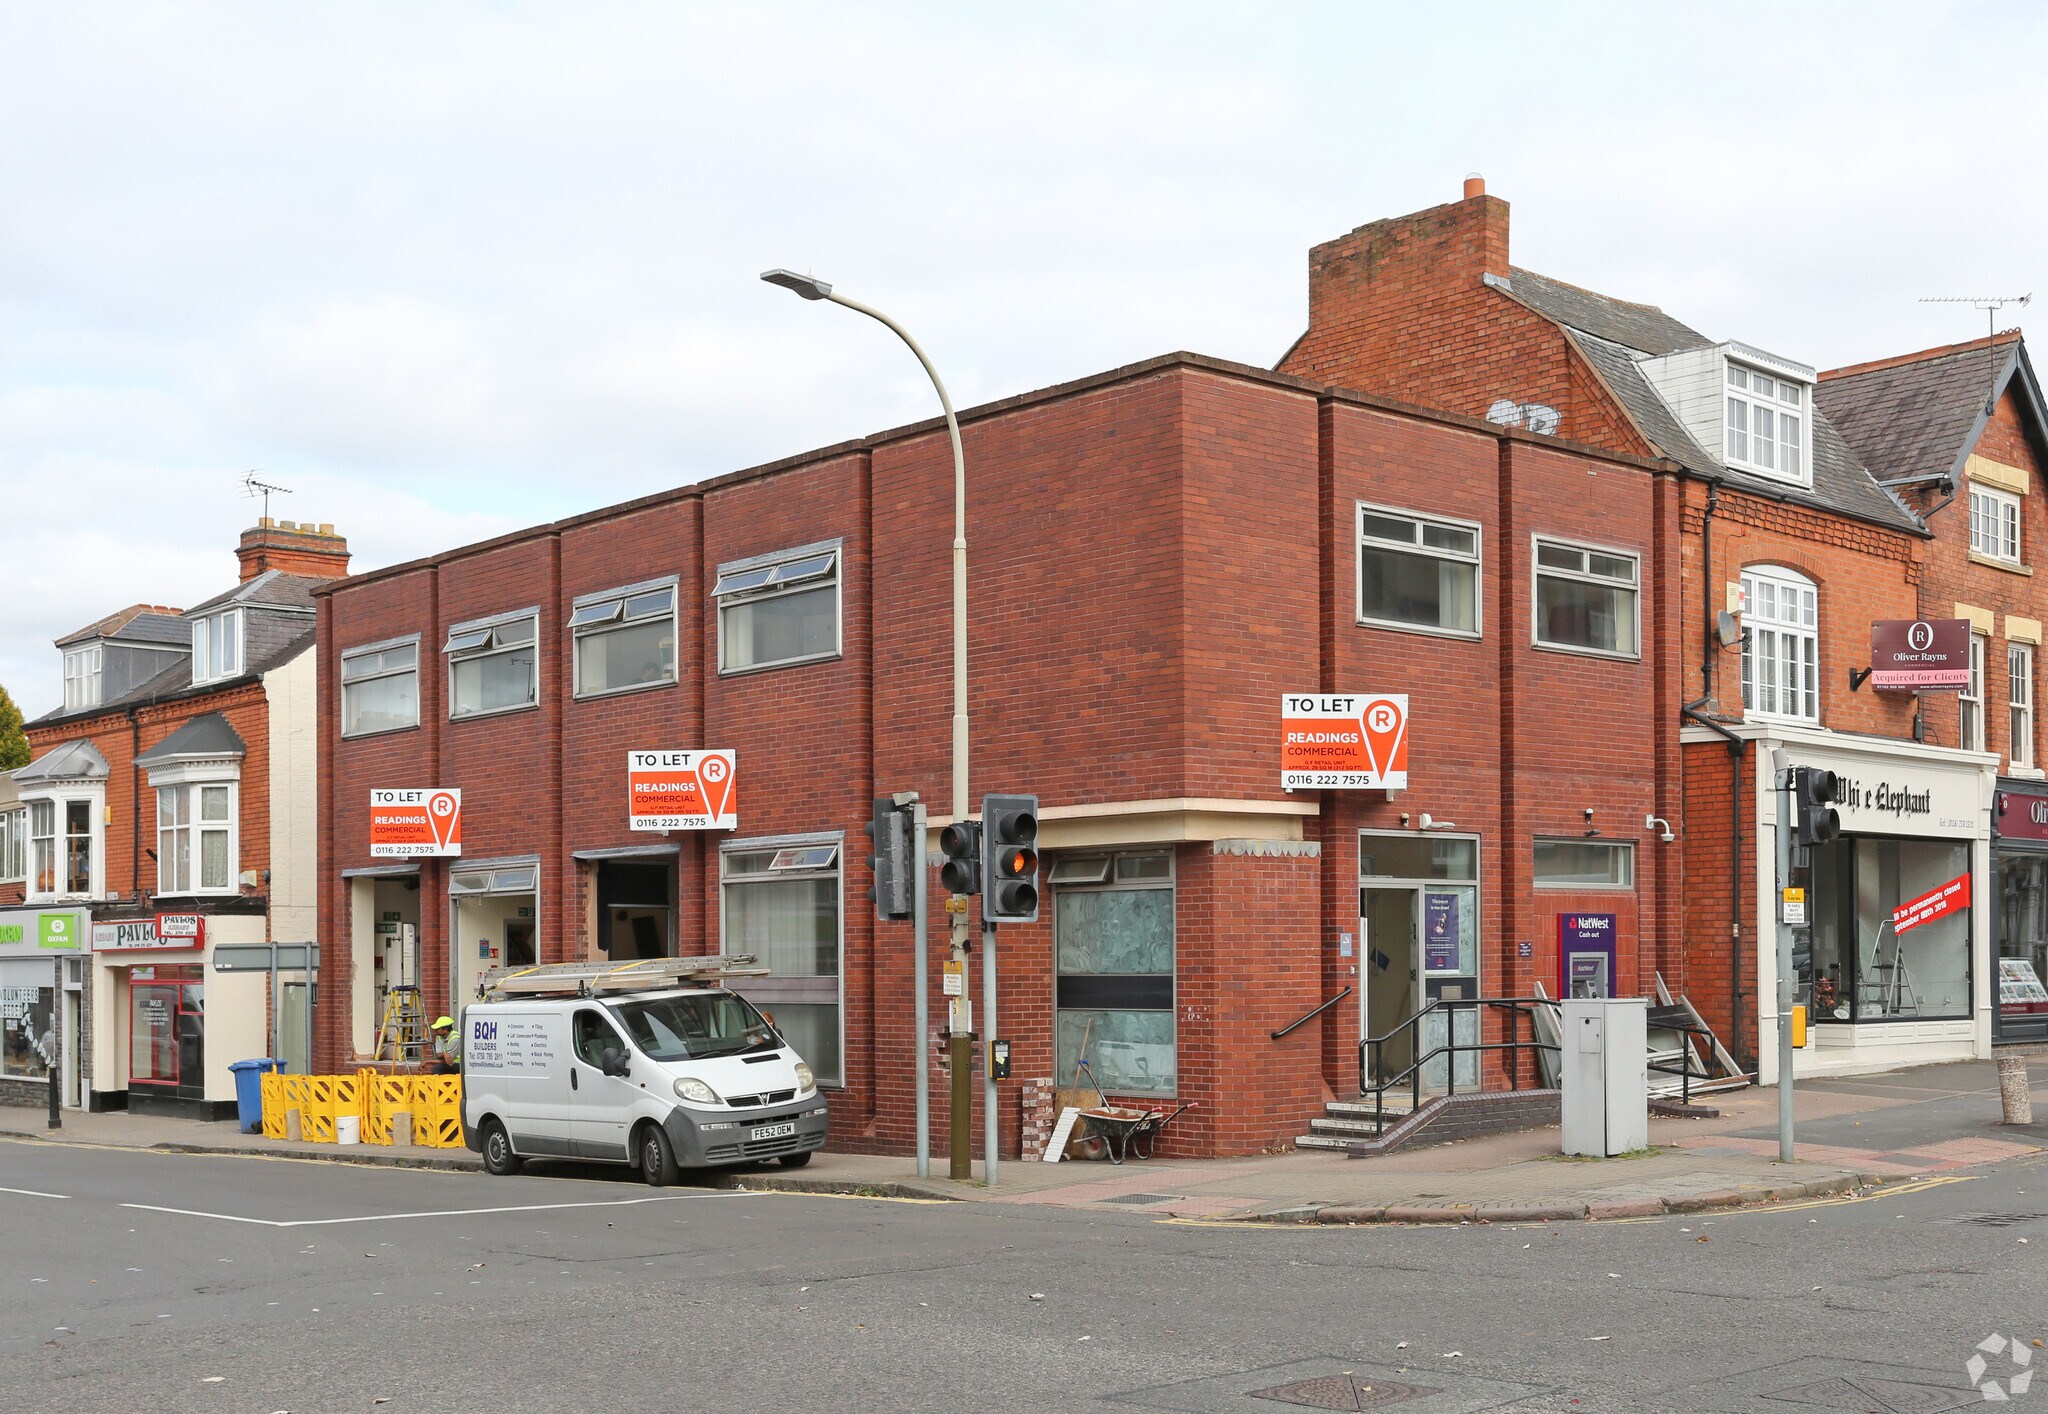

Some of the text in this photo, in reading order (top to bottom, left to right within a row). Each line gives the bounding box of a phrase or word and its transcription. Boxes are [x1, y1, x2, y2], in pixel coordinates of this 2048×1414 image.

[1916, 631, 1925, 642] R
[1893, 652, 1947, 662] Oliver Rayns
[1873, 673, 1968, 683] Acquired for Clients
[1289, 698, 1354, 712] TO LET
[1375, 710, 1390, 727] R
[1287, 732, 1359, 743] READINGS
[1287, 747, 1358, 756] COMMERCIAL
[635, 754, 691, 766] TO LET
[709, 763, 720, 777] R
[1287, 775, 1370, 785] 0116 222 7575
[635, 782, 696, 793] READINGS
[376, 792, 423, 802] TO LET
[635, 795, 695, 803] COMMERCIAL
[1875, 782, 1931, 819] Elephant
[438, 800, 448, 812] R
[2030, 800, 2048, 824] Oli
[375, 816, 427, 825] READINGS
[636, 818, 706, 827] 0116 222 7575
[1900, 909, 1908, 918] be
[1909, 891, 1943, 915] permanently
[1944, 881, 1961, 896] closed
[164, 916, 196, 924] PAVLOS
[1578, 917, 1609, 929] NatWest
[474, 1021, 498, 1041] BQH
[474, 1042, 497, 1051] BUILDERS
[754, 1127, 776, 1139] FE52
